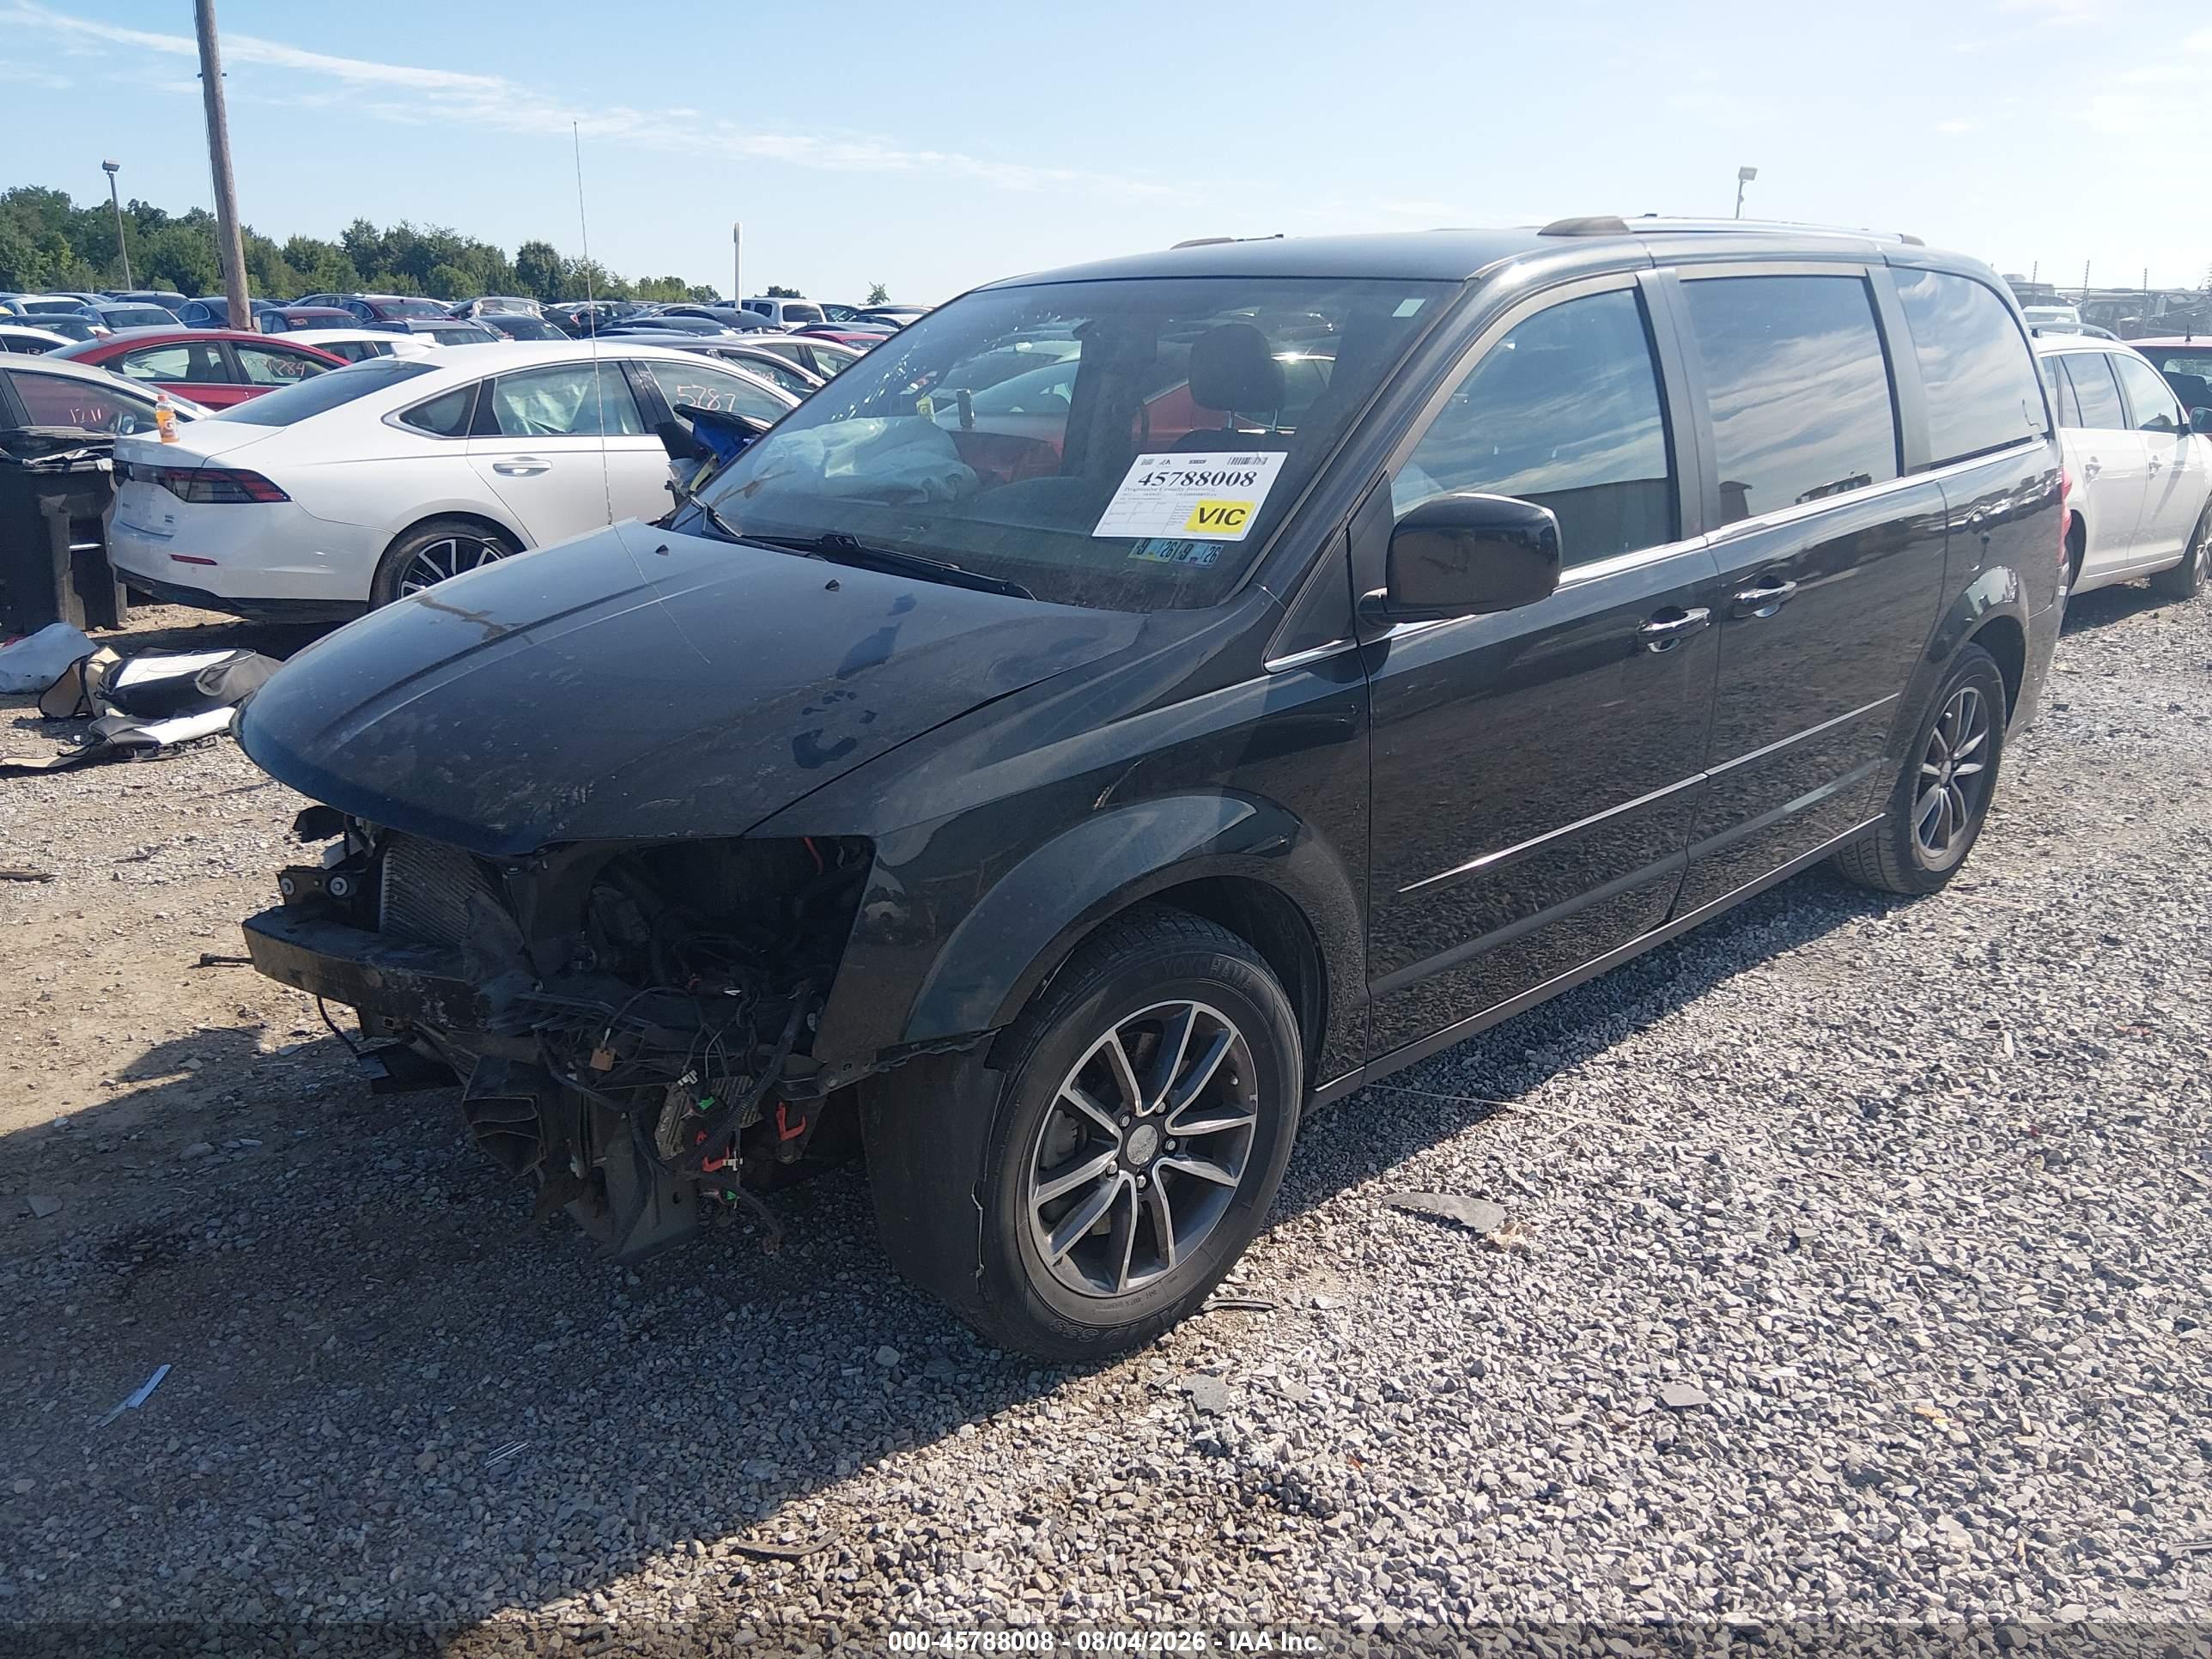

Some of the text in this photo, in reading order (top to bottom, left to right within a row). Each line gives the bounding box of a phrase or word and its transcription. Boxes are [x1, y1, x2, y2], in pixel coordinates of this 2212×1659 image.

[677, 385, 736, 412] 5787
[1138, 471, 1257, 487] 45788008
[1199, 507, 1246, 526] VIC
